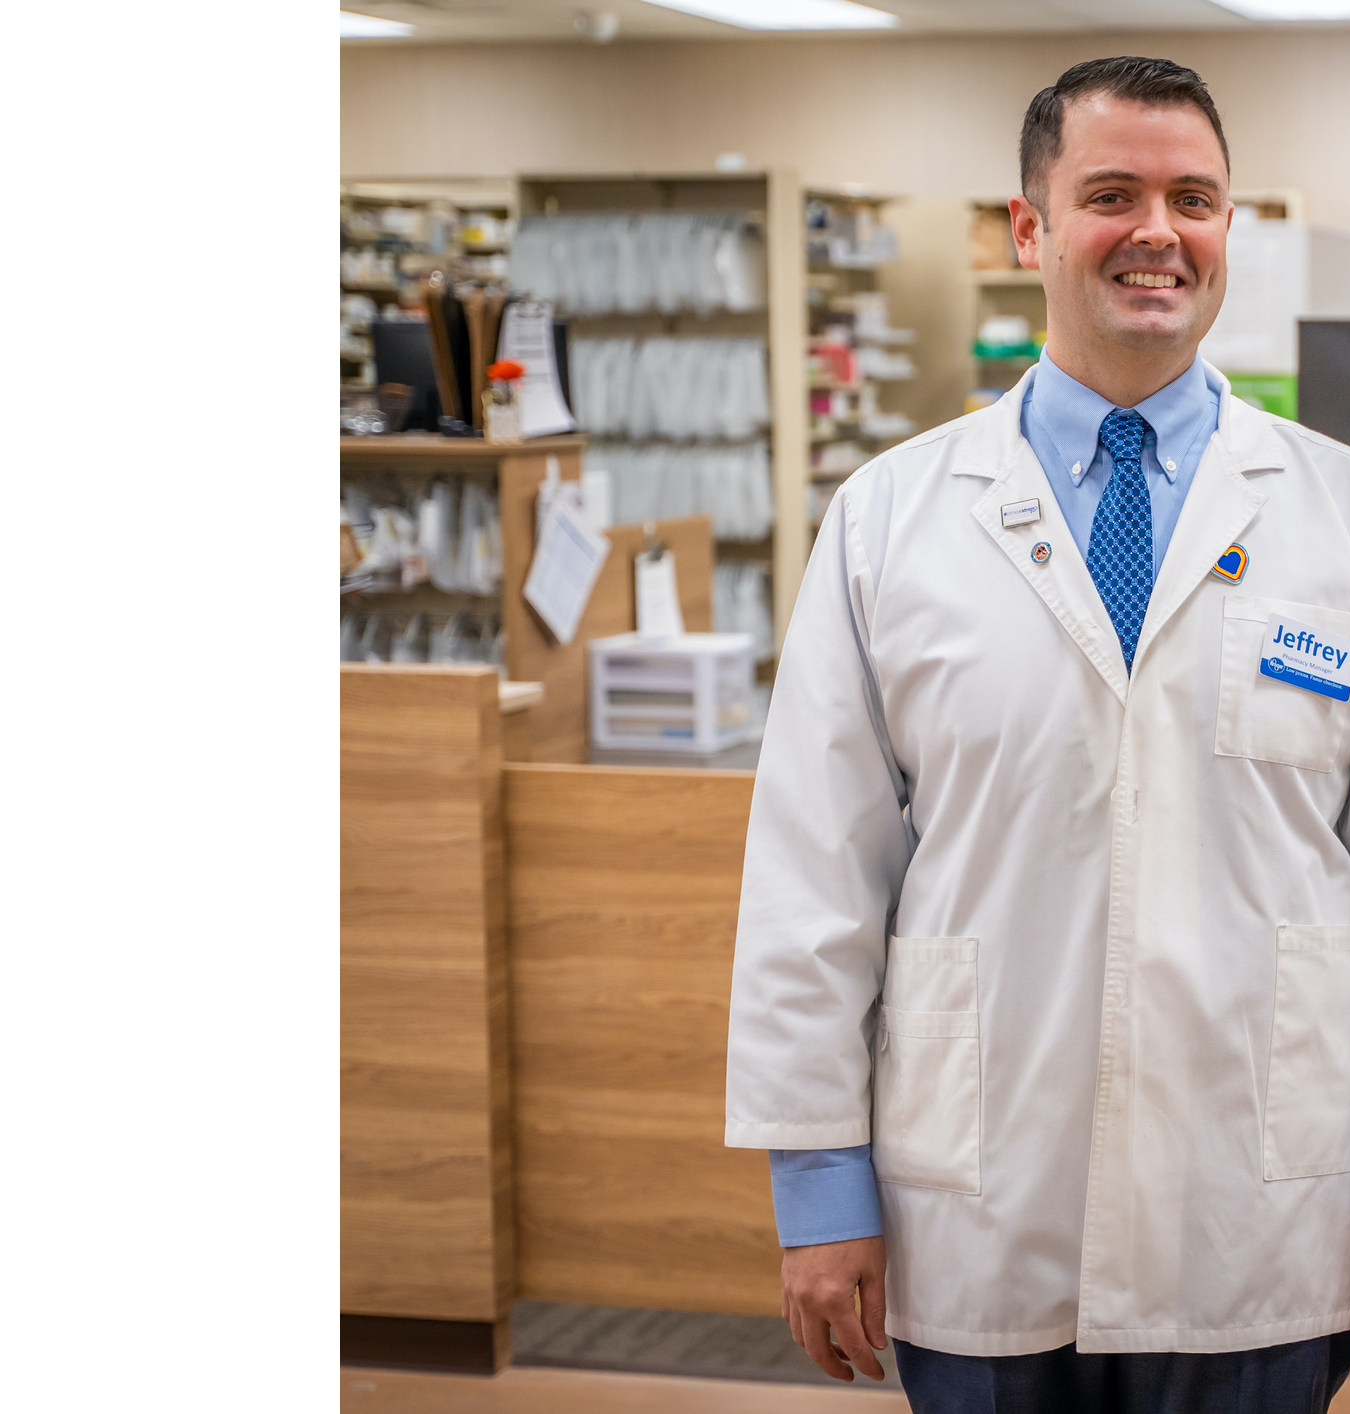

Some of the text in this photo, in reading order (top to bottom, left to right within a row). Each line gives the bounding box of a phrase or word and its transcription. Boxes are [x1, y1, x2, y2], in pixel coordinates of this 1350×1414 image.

[1273, 624, 1348, 669] Jeffrey
[1282, 653, 1333, 675] Pharmacy Manager
